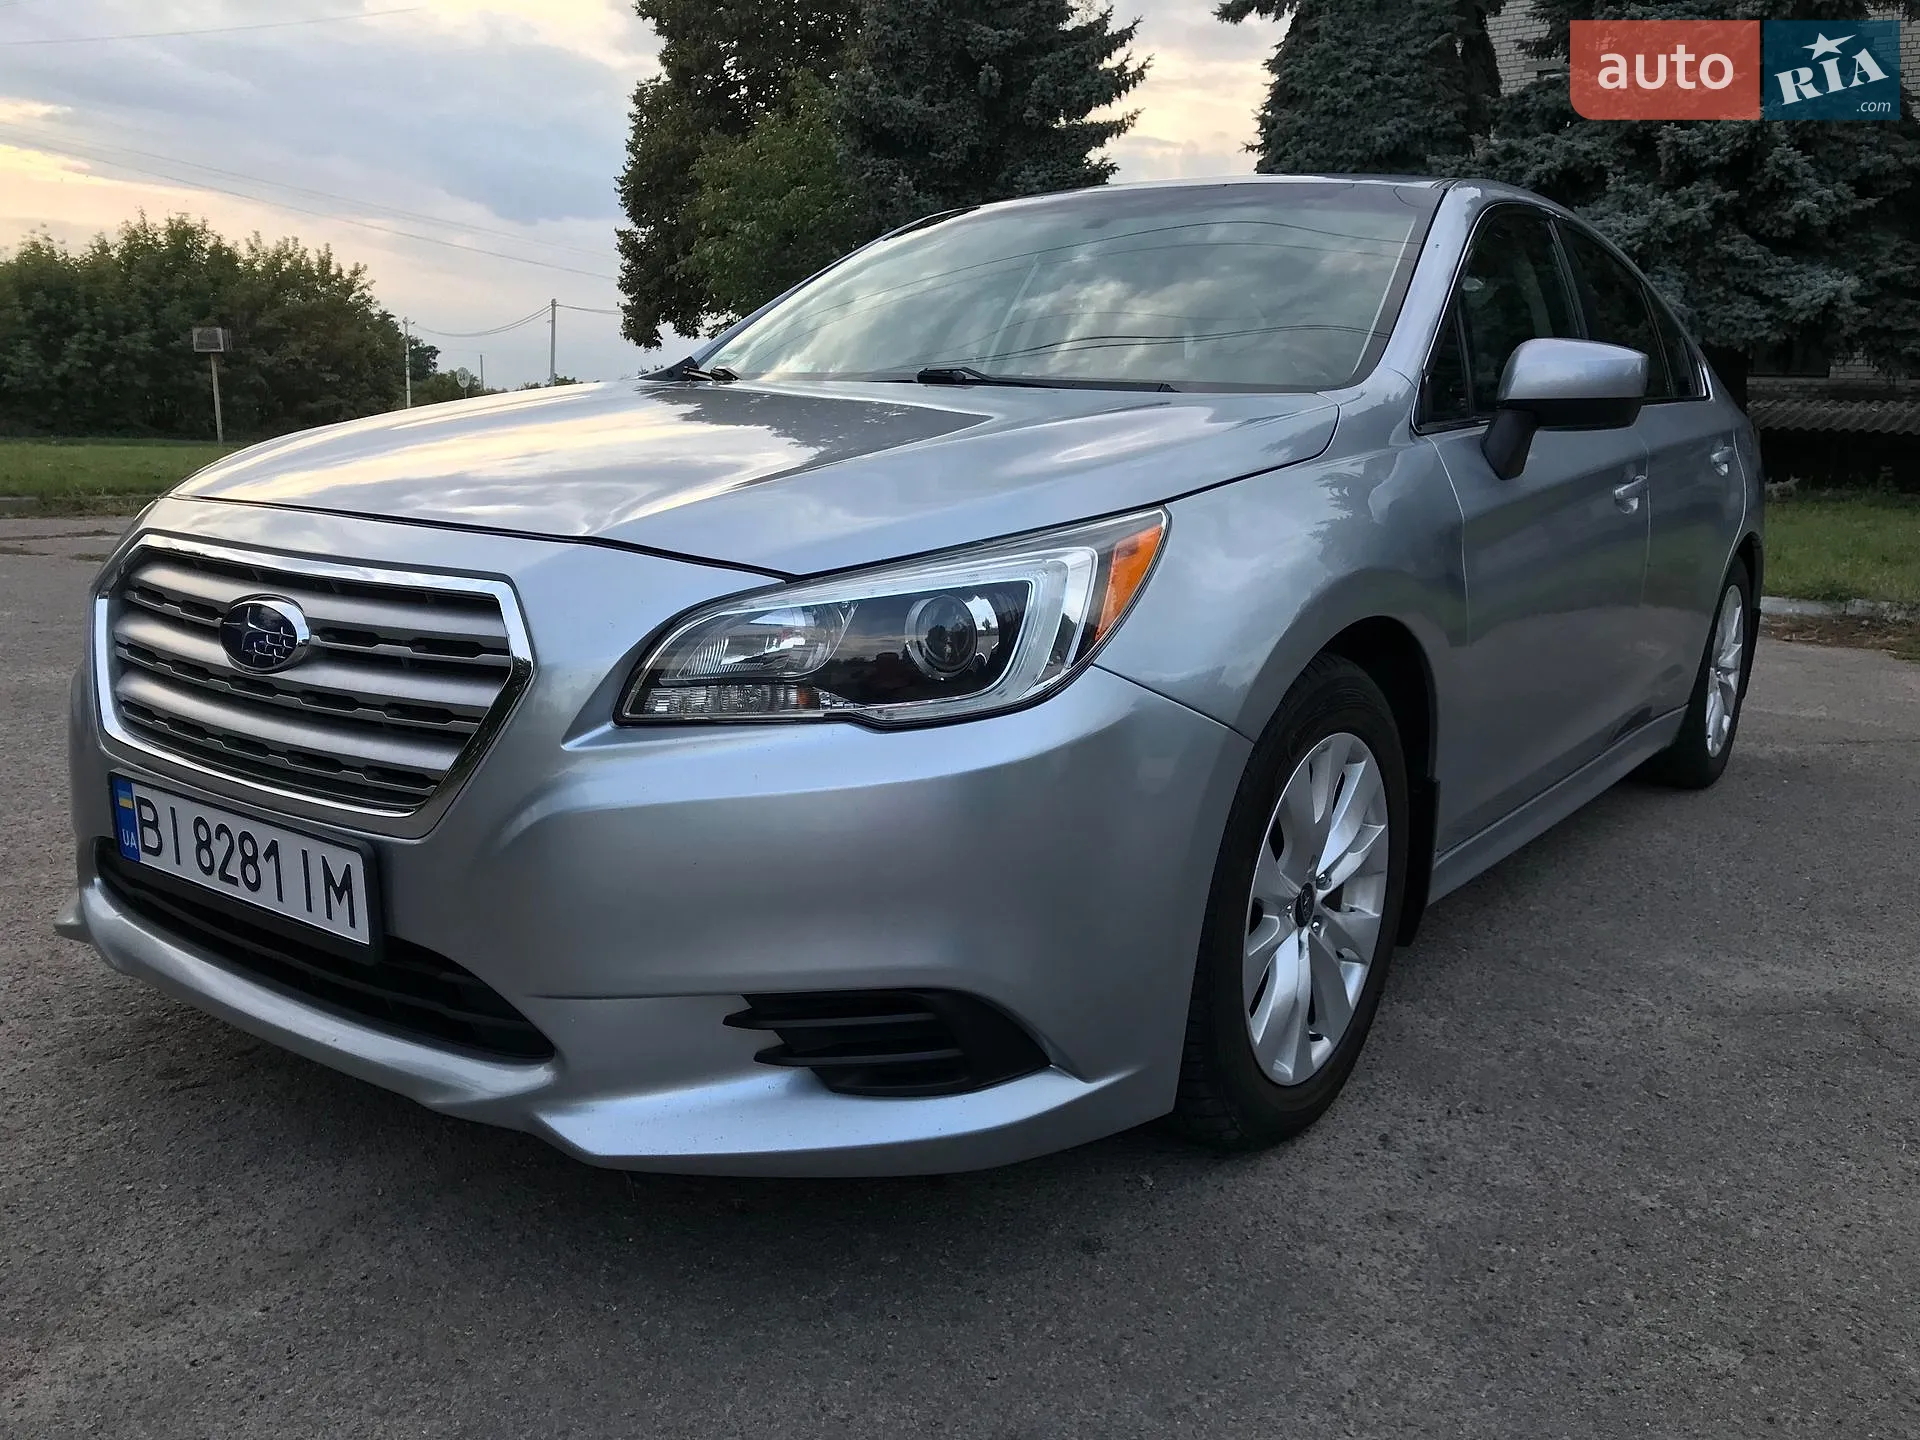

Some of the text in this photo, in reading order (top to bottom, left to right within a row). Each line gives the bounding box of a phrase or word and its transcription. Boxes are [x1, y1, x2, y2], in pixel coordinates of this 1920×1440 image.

[122, 828, 138, 850] UA
[136, 795, 356, 929] BI 8281 IM
